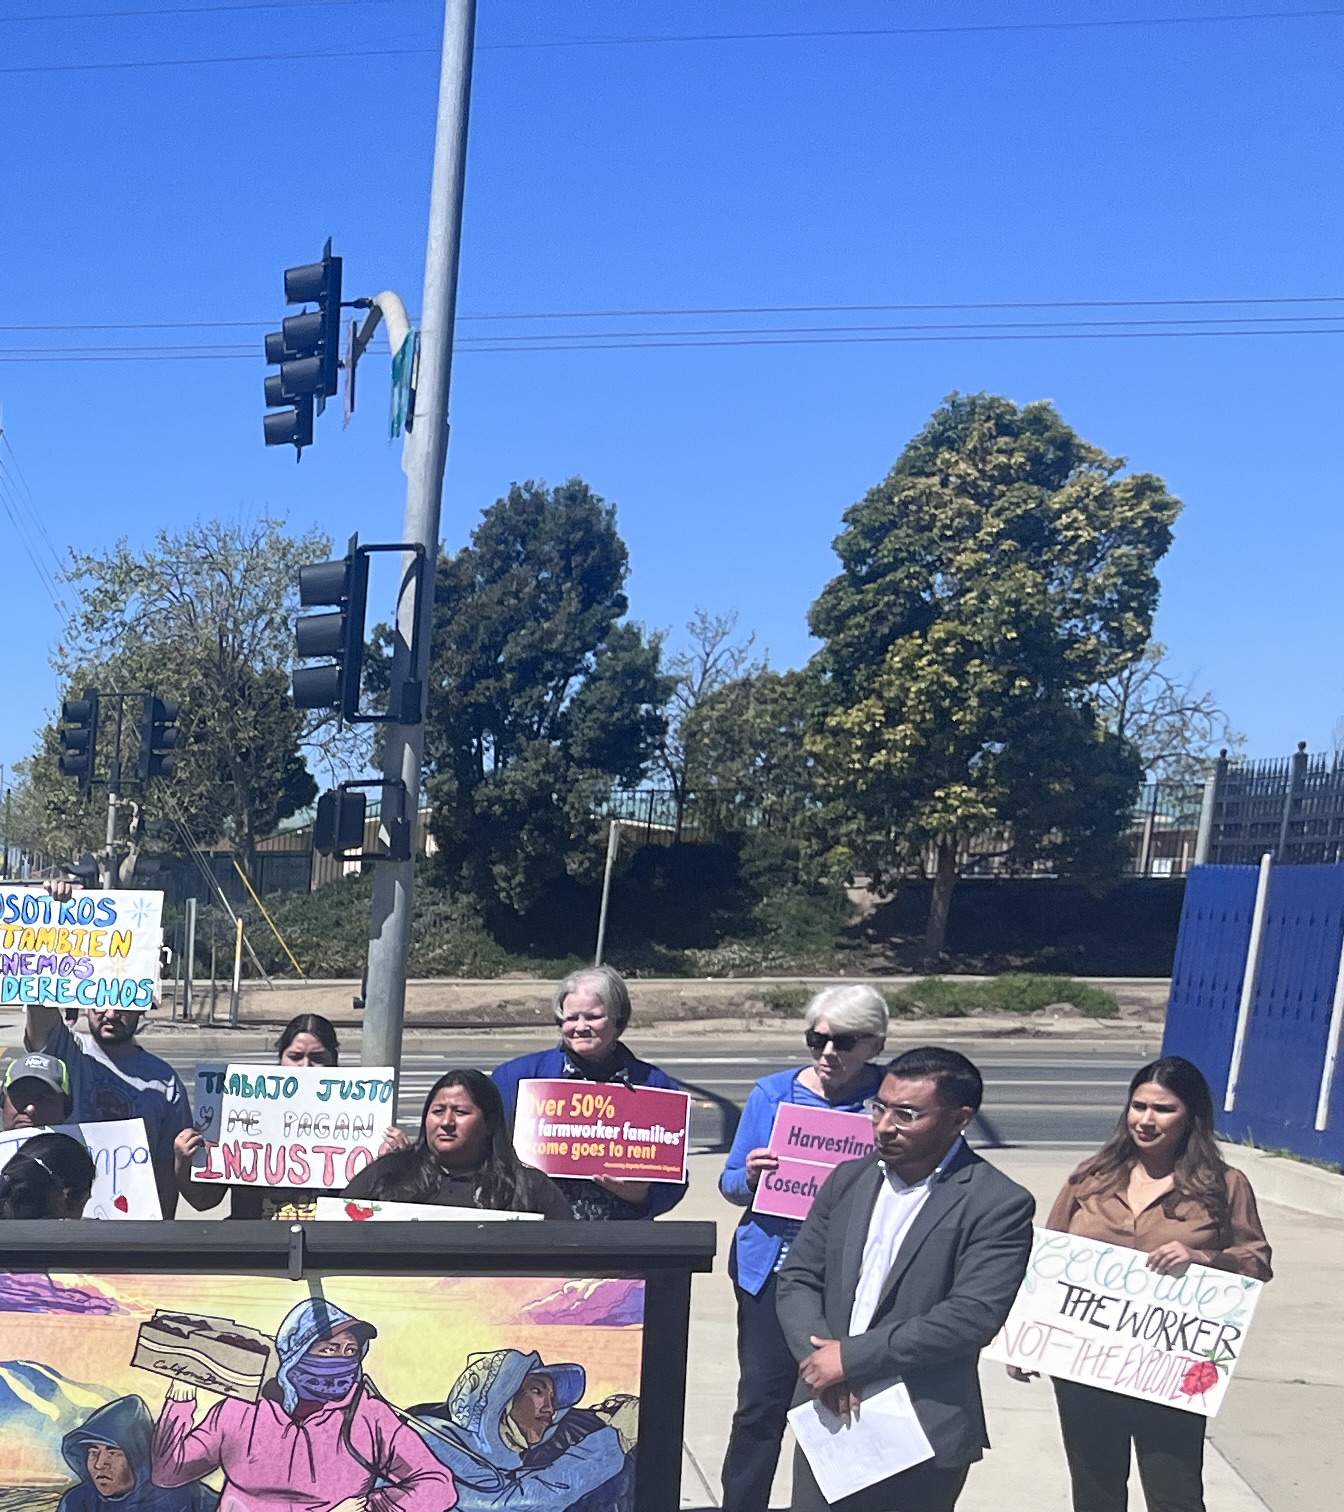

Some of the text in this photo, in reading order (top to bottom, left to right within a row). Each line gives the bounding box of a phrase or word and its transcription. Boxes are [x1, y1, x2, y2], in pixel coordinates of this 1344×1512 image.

[1, 976, 154, 1008] DERECHOS
[198, 1071, 393, 1102] TRABAJO JUSTO
[570, 1092, 615, 1119] 50%
[227, 1109, 262, 1136] ME
[283, 1110, 375, 1140] PAGAN
[538, 1118, 620, 1140] farmworker
[571, 1142, 605, 1161] goes
[609, 1141, 624, 1157] to
[627, 1144, 657, 1160] rent
[787, 1125, 874, 1157] Harvesting
[764, 1171, 818, 1197] Cosech
[1058, 1280, 1241, 1359] THE WORKER
[992, 1321, 1074, 1361] NOT
[1072, 1336, 1123, 1380] THE
